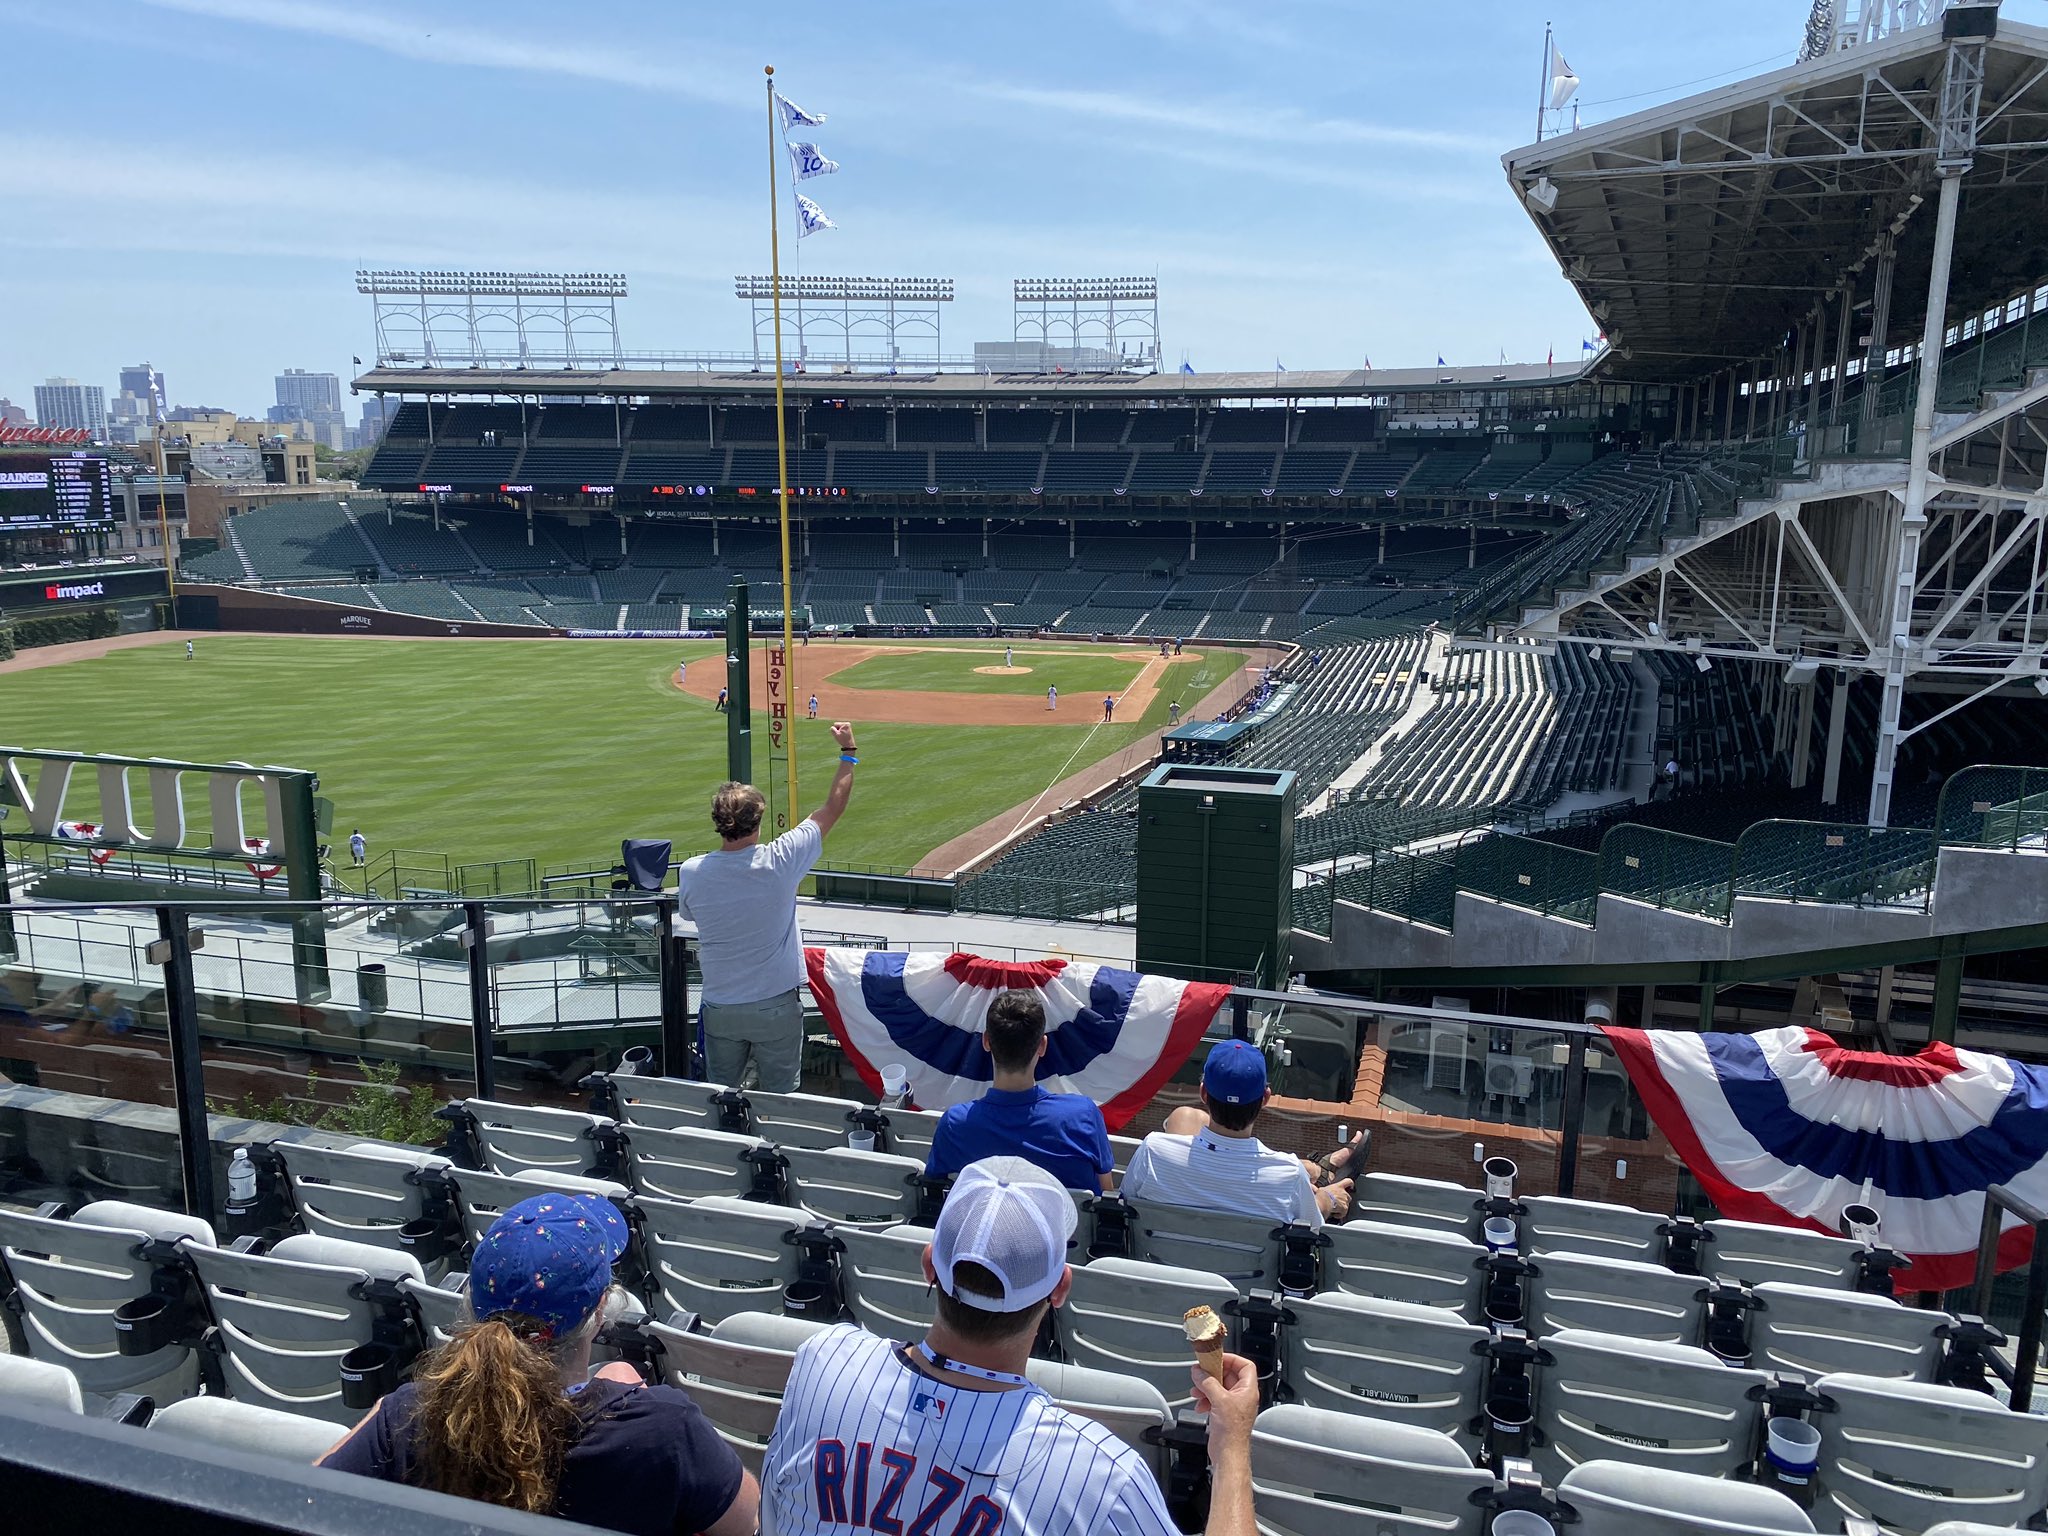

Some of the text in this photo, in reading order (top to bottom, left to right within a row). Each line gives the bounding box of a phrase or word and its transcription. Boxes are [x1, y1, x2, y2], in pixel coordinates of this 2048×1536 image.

[802, 156, 823, 173] 10
[425, 483, 452, 492] impact
[506, 484, 533, 492] impact
[587, 485, 614, 493] impact
[688, 486, 693, 495] 1
[709, 486, 713, 495] 1
[56, 581, 103, 599] impact
[340, 615, 372, 626] MARQUEE
[569, 629, 628, 638] Reynolds Wrap
[641, 629, 700, 639] Reynolds Wrap
[1360, 1388, 1409, 1403] UNAVAILABLE
[815, 1439, 1003, 1536] RIZZO
